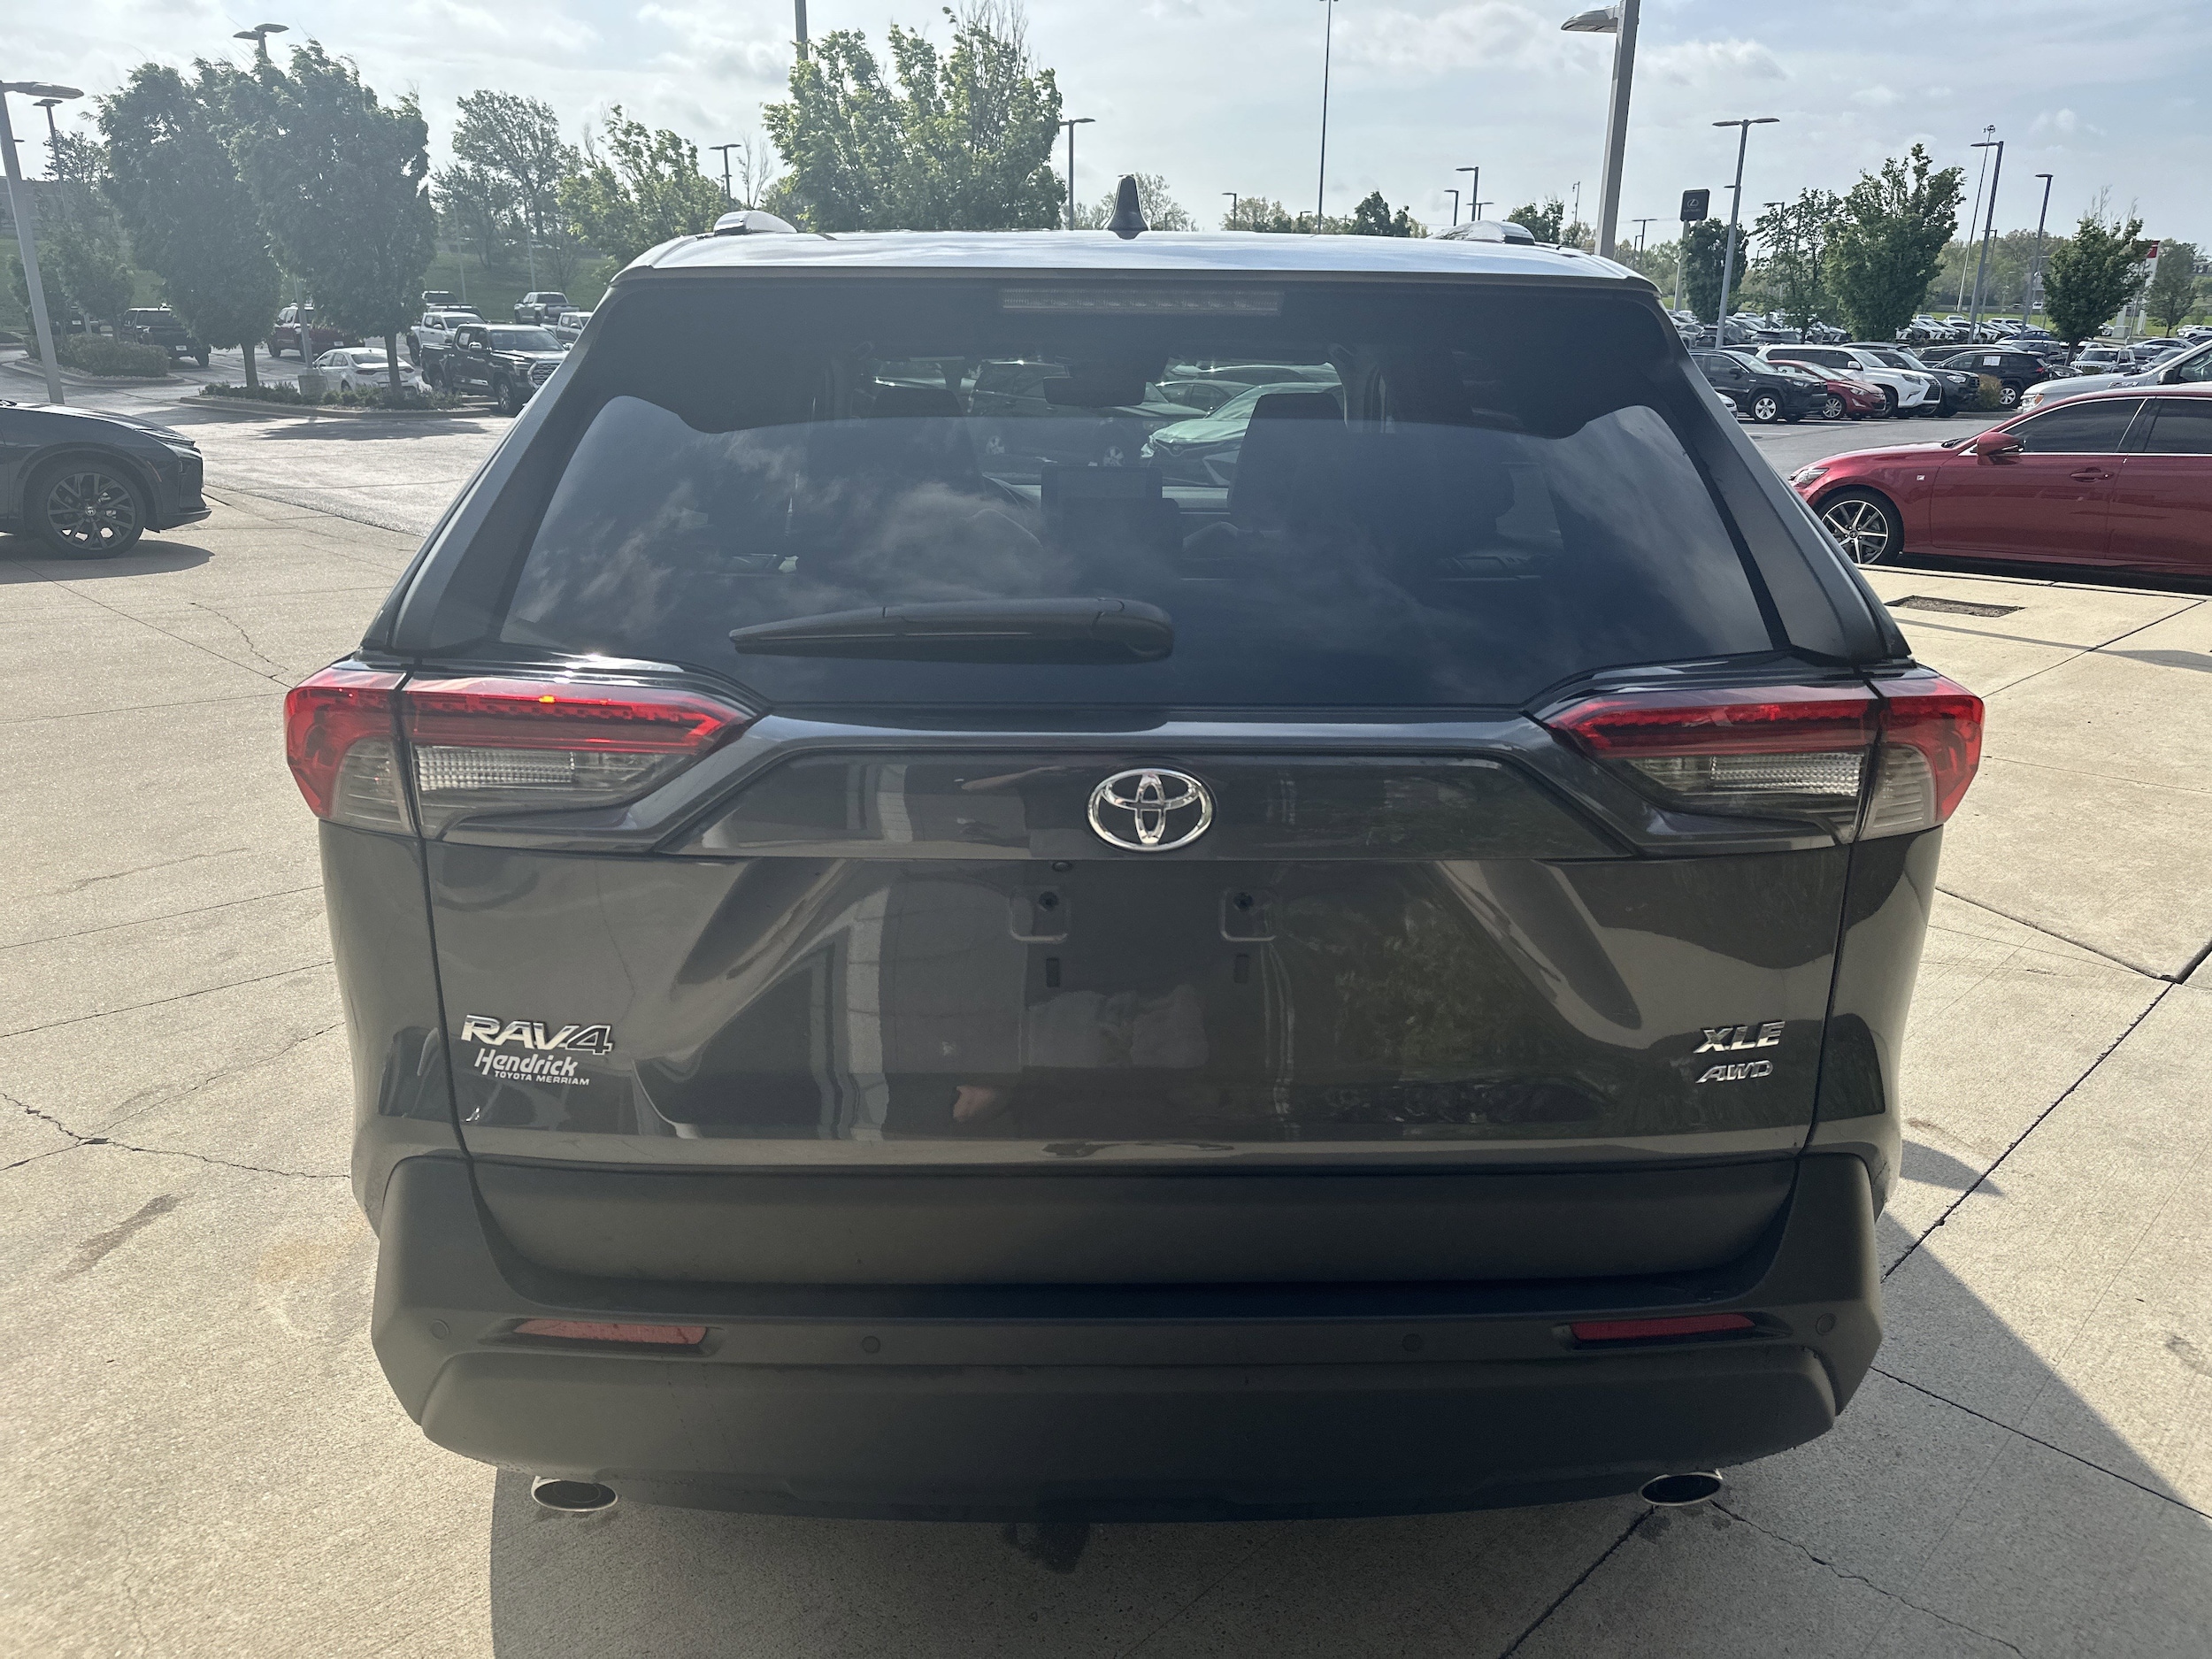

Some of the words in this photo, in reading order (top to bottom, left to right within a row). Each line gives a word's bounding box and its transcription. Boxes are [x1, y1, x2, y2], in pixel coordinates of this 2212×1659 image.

[461, 1014, 614, 1056] RAV4
[1694, 1020, 1786, 1054] XLE
[474, 1048, 579, 1077] Hendrick
[1695, 1059, 1774, 1084] AWD
[494, 1070, 533, 1082] TOYOTA
[535, 1074, 590, 1086] MERRIAM
